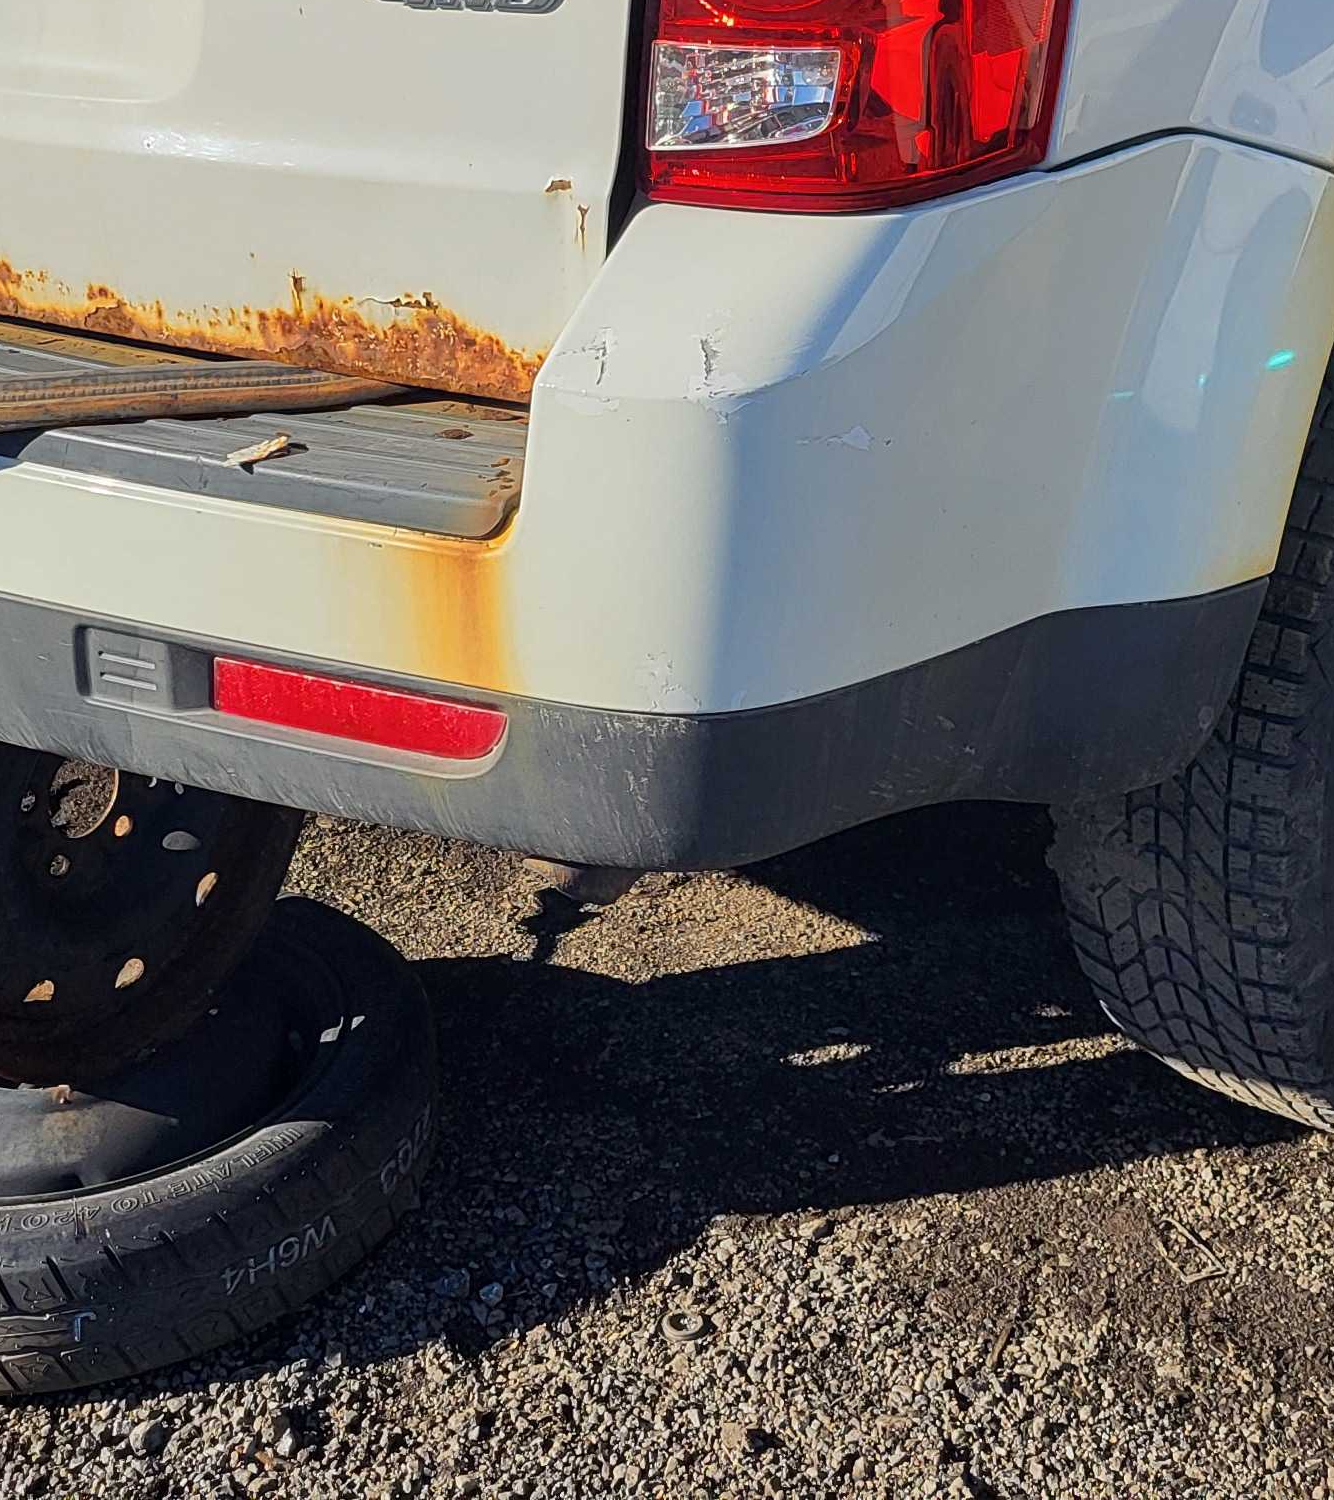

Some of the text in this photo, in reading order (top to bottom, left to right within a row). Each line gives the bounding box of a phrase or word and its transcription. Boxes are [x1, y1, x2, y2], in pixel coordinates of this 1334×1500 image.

[168, 1127, 304, 1198] INFLATE
[110, 1188, 162, 1214] TO
[22, 1204, 101, 1233] 420
